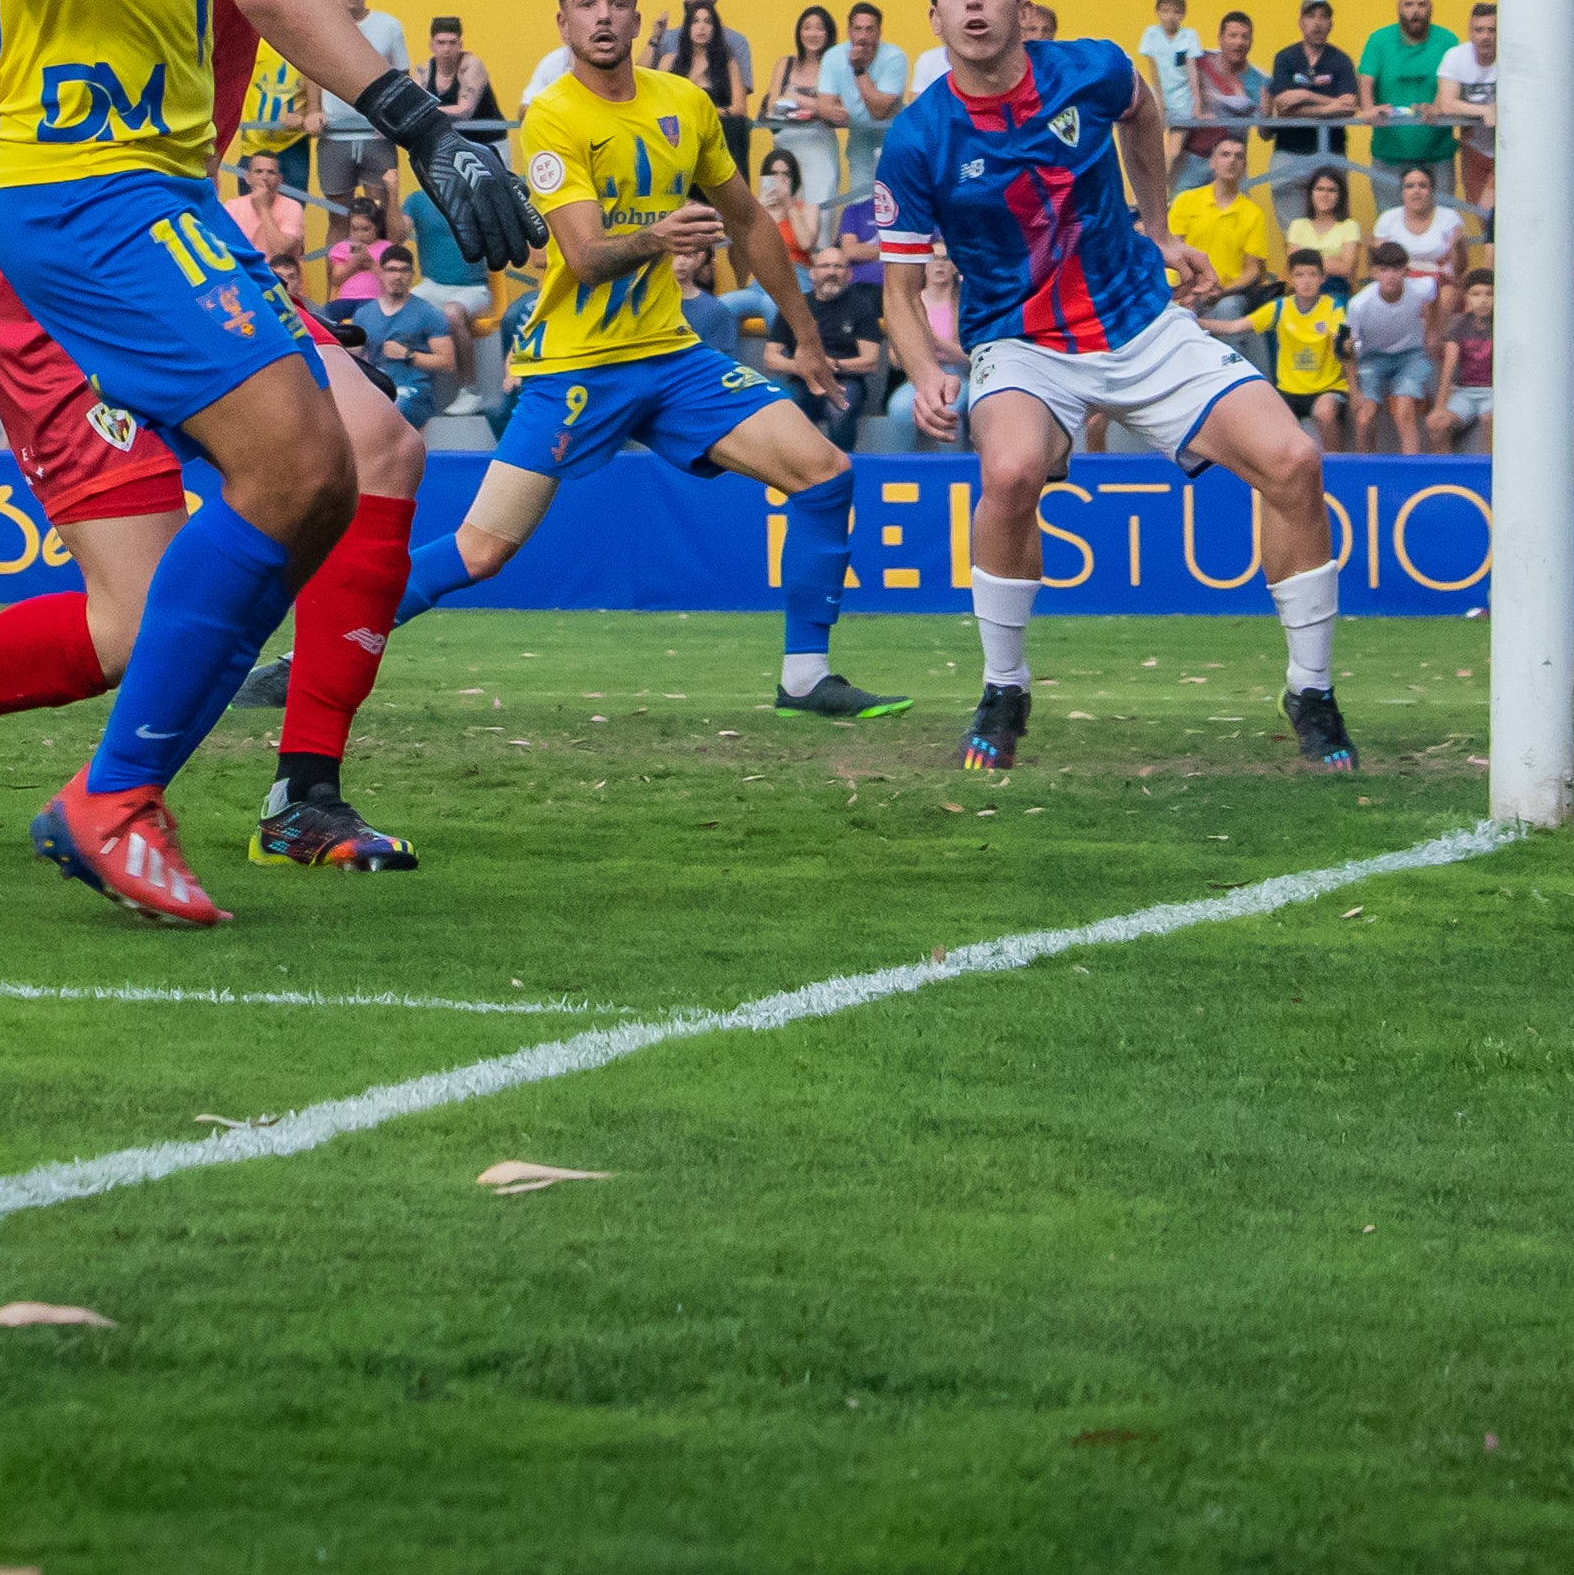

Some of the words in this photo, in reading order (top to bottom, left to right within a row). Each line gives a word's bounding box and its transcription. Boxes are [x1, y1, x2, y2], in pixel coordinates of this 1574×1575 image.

[36, 61, 172, 143] DM
[149, 213, 237, 288] 10
[564, 385, 589, 426] 9
